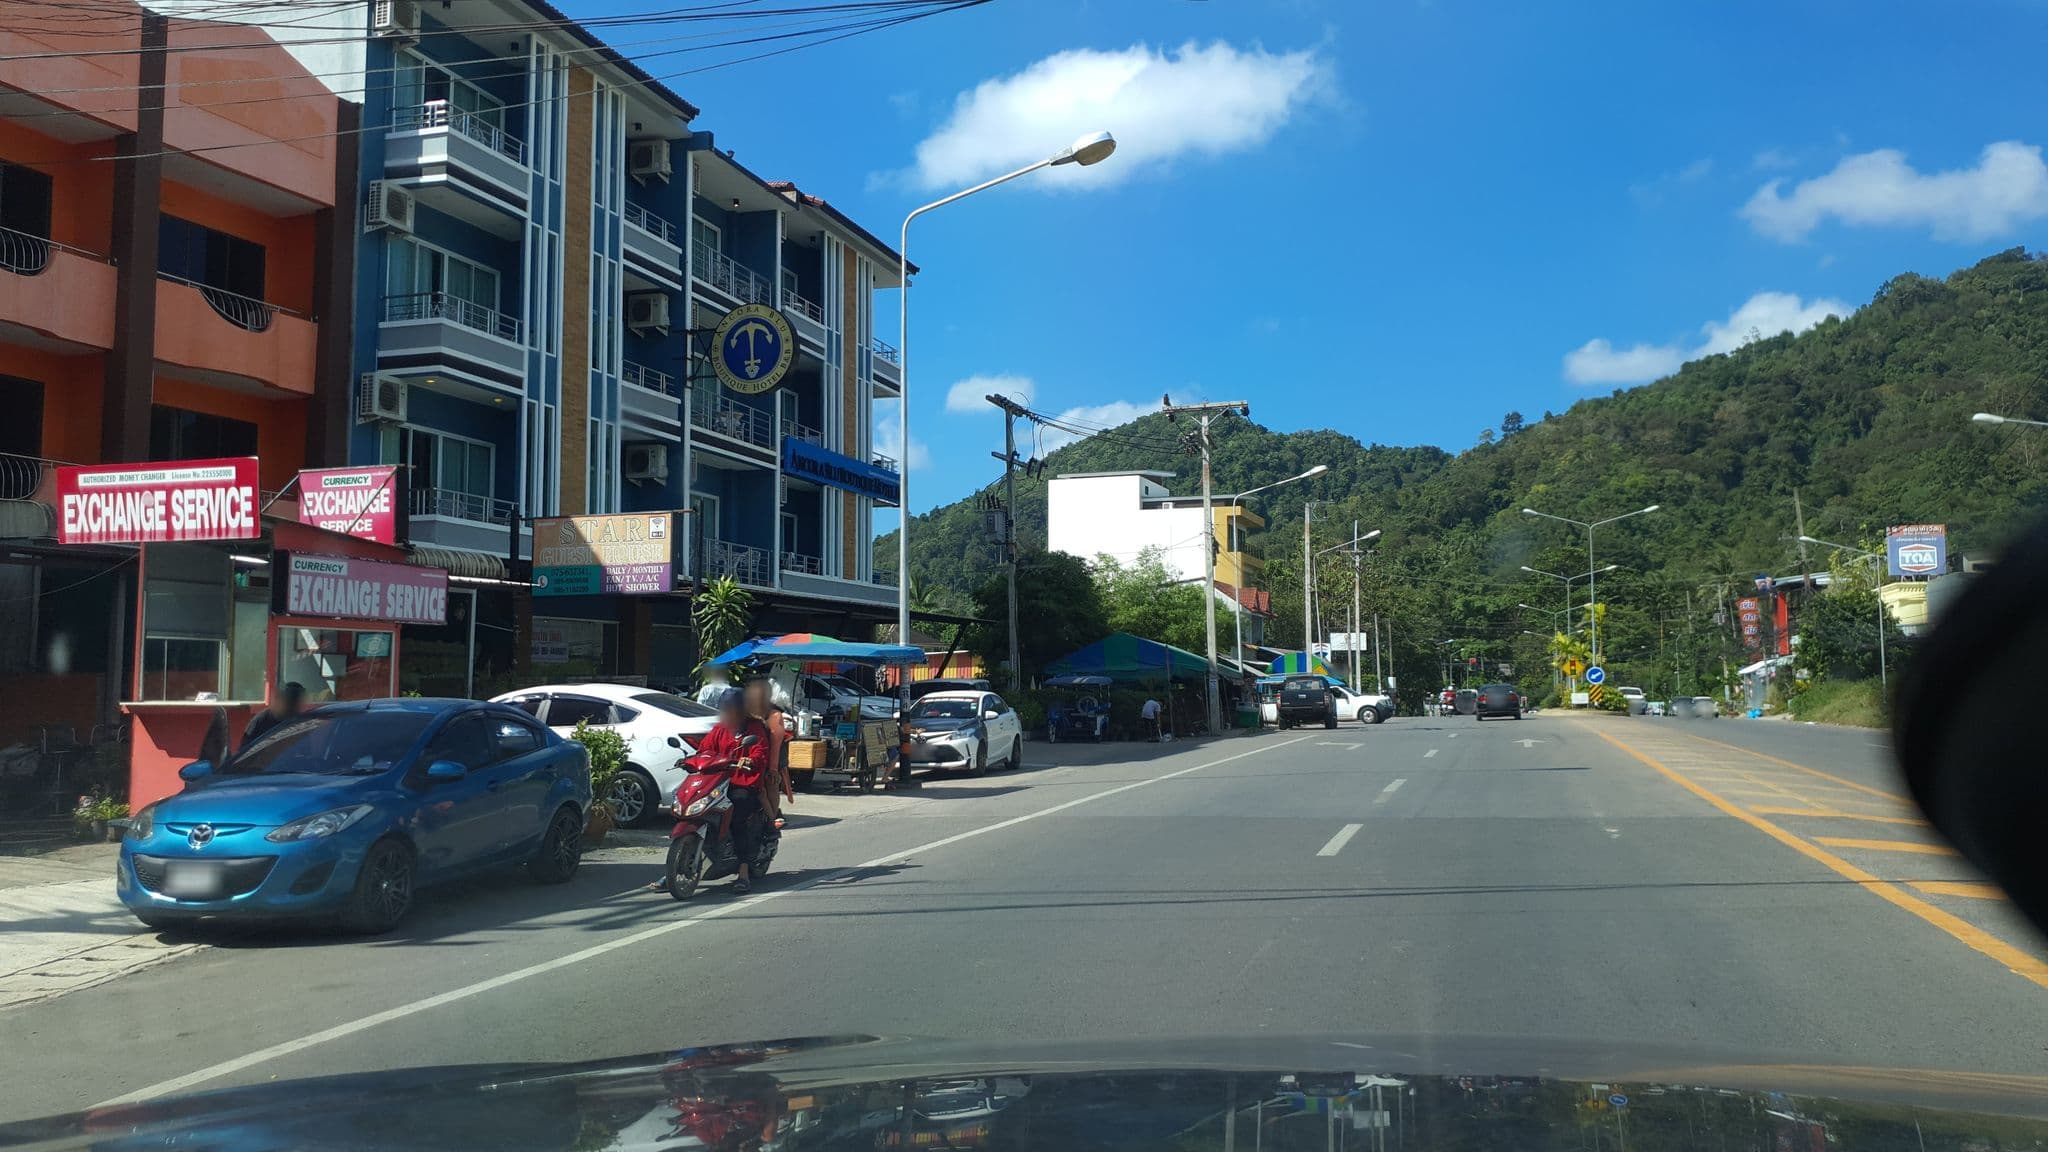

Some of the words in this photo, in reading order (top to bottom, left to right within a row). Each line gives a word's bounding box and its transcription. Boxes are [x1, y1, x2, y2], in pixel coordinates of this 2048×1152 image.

[753, 372, 781, 391] HOTEL
[119, 473, 140, 482] MONEY
[141, 471, 166, 481] CHANGER
[323, 475, 369, 486] CURRENCY
[303, 488, 390, 516] EXCHANGE
[63, 490, 168, 534] EXCHANGE
[171, 486, 254, 531] SERVICE
[320, 518, 373, 533] SERVICE
[559, 517, 644, 547] STAR
[540, 546, 593, 566] GUEST
[603, 543, 664, 566] HOUSE
[1902, 552, 1934, 564] TOA
[294, 560, 344, 573] CURRENCY
[606, 567, 626, 575] DAILY
[632, 565, 664, 574] MONTHLY
[606, 583, 623, 592] HOT
[625, 582, 660, 591] SHOWER
[289, 574, 381, 616] EXCHANGE
[386, 583, 446, 621] SERVICE
